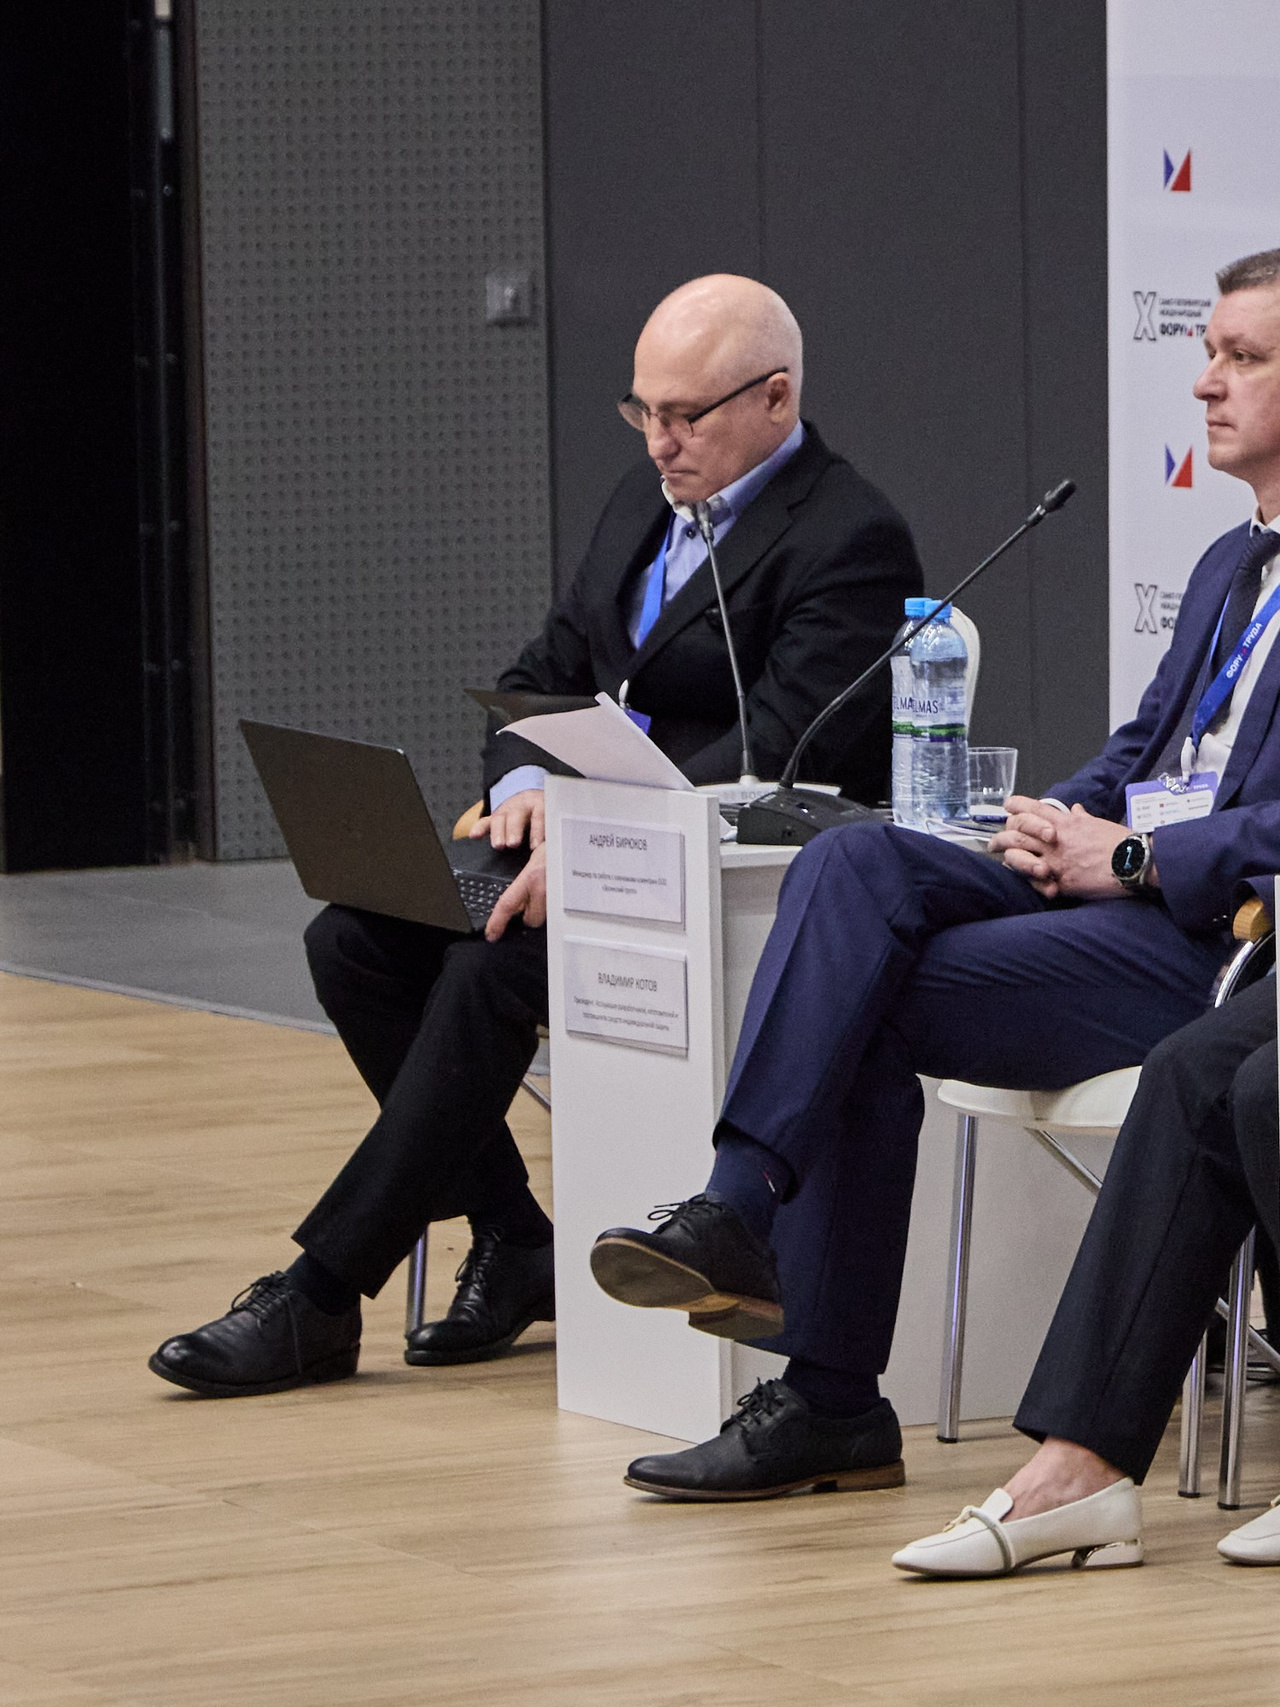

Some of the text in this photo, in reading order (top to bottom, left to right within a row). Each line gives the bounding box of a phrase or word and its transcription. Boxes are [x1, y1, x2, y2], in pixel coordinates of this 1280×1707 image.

[1242, 622, 1263, 648] ТРУДА
[589, 834, 647, 851] АНДРЕЙ БИРЮКОВ
[598, 972, 657, 992] ВЛАДИМИР КОТОВ
